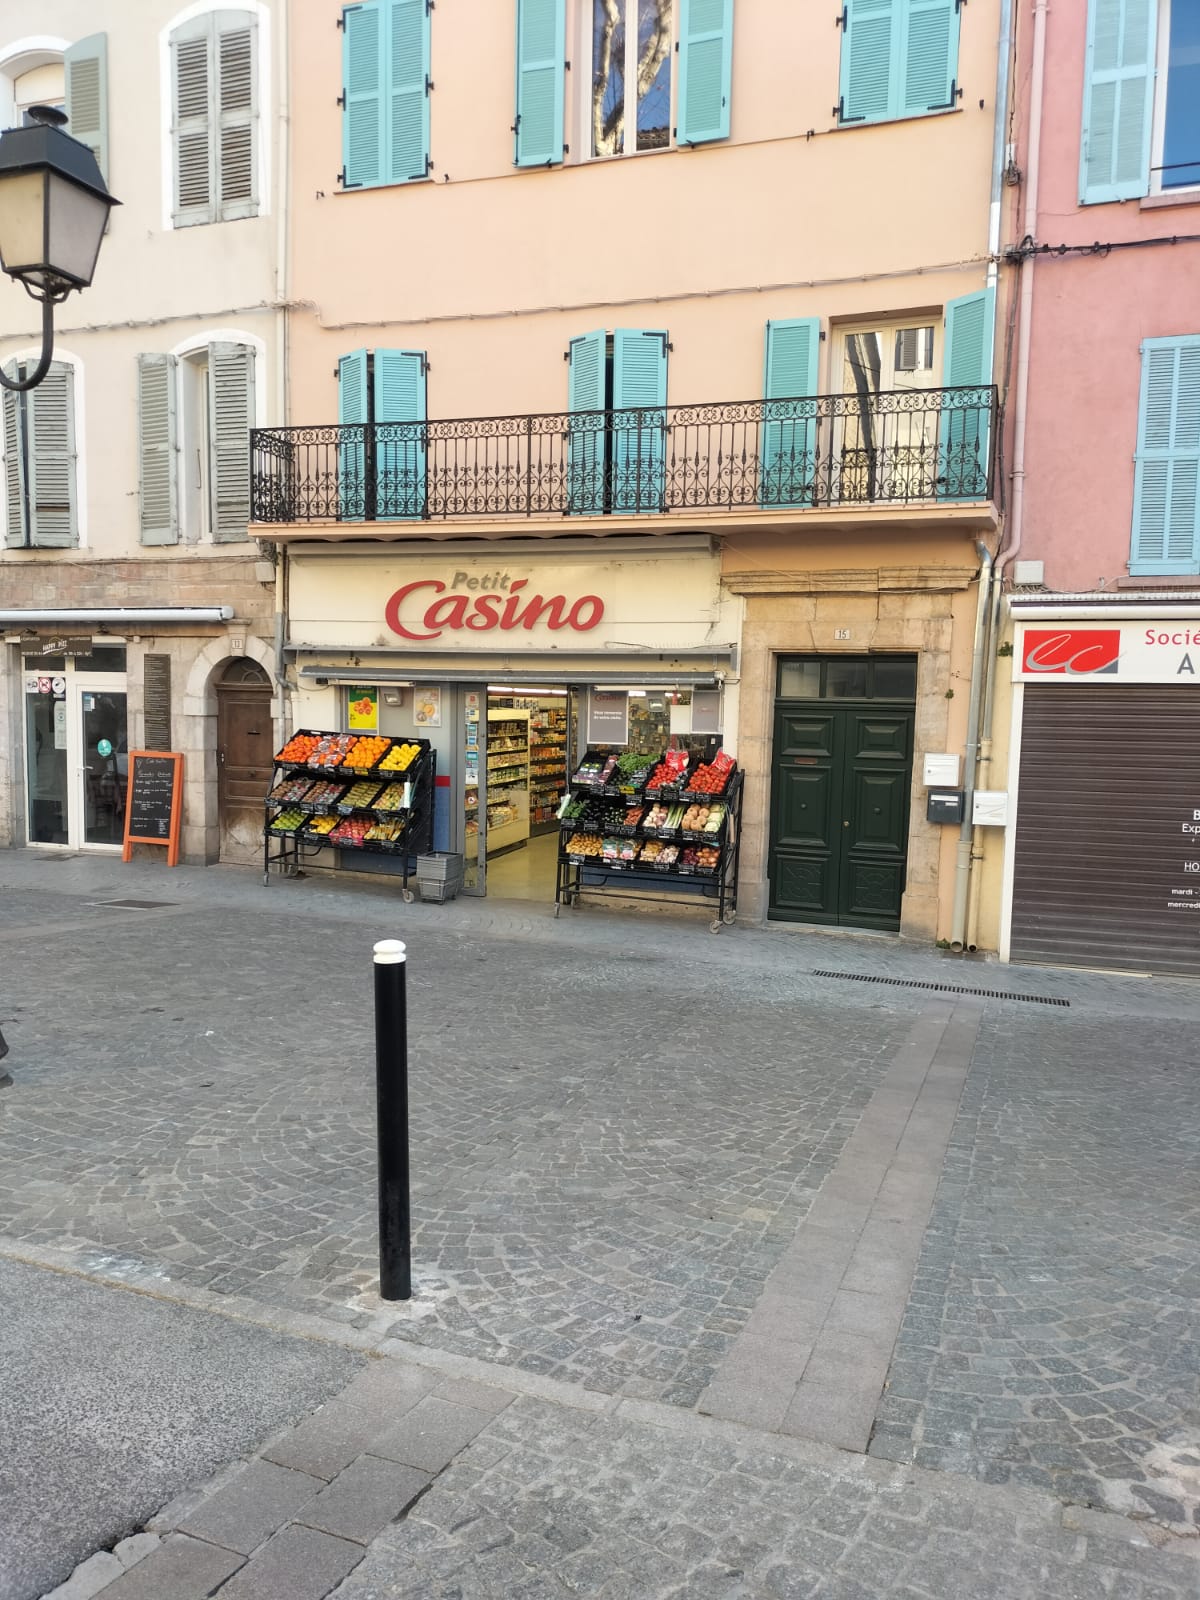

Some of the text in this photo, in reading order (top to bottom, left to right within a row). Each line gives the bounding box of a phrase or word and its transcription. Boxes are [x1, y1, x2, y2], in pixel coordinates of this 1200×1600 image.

[451, 571, 511, 590] Petit
[385, 578, 605, 641] Casino
[838, 630, 847, 639] 15
[1177, 652, 1195, 674] A
